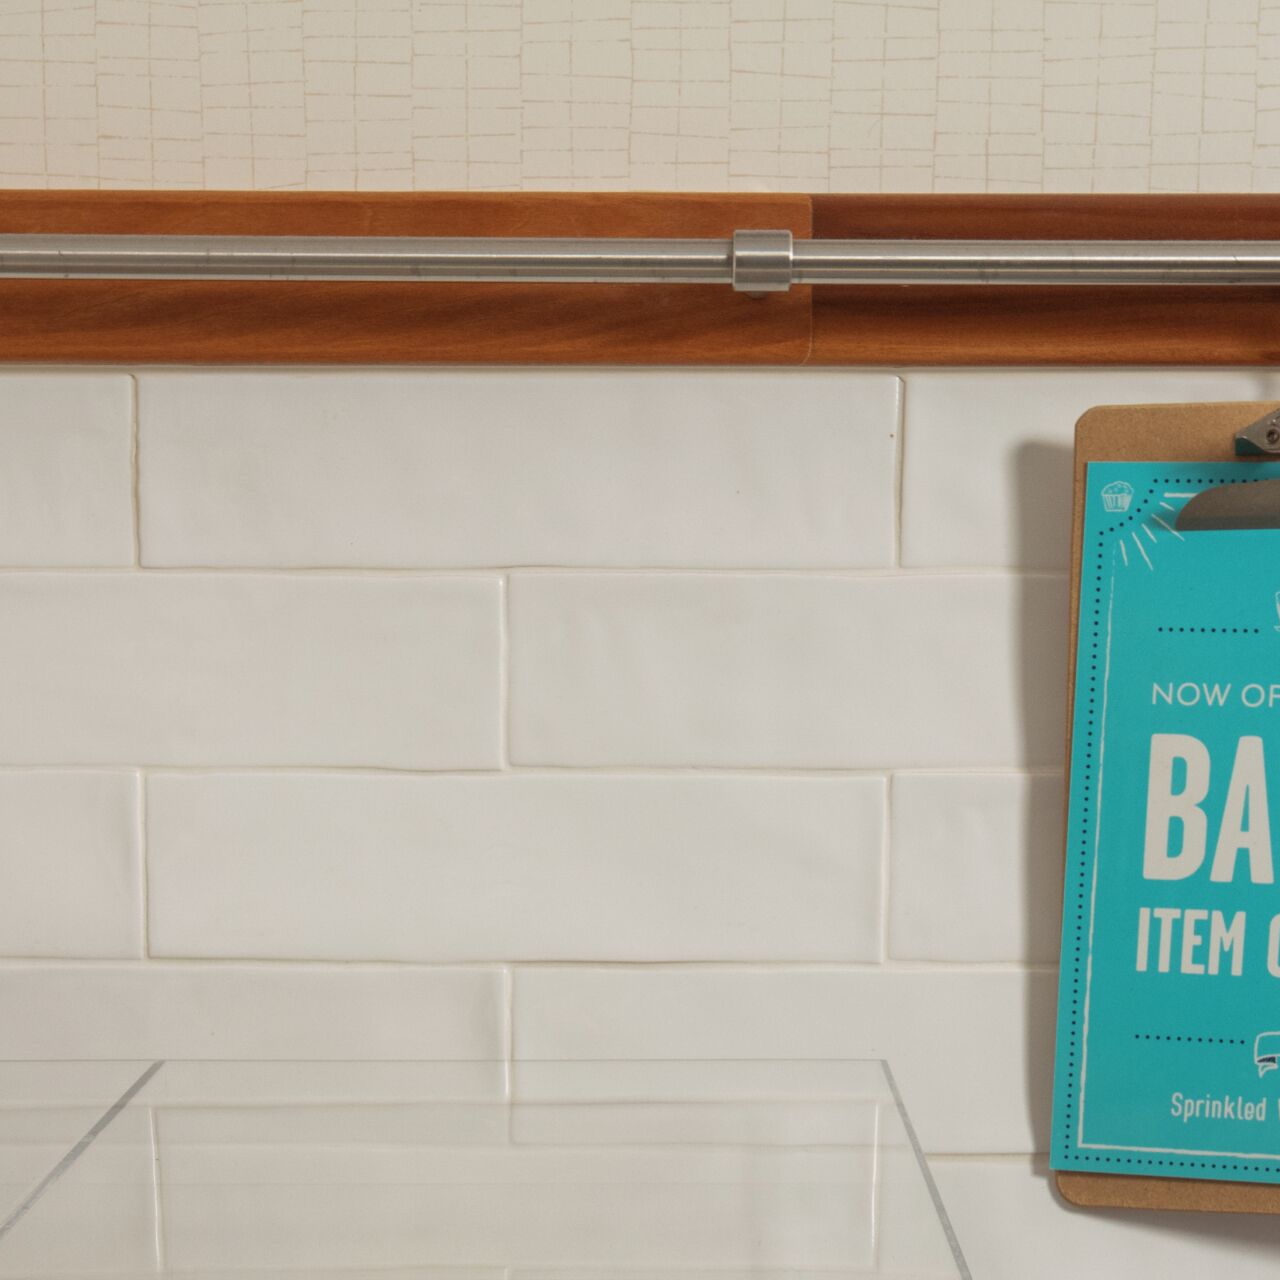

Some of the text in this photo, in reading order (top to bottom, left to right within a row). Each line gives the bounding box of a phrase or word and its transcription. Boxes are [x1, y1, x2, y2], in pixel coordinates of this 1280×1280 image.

[1152, 682, 1231, 706] NOW
[1135, 907, 1246, 977] ITEM
[1171, 1092, 1267, 1122] Sprinkled
